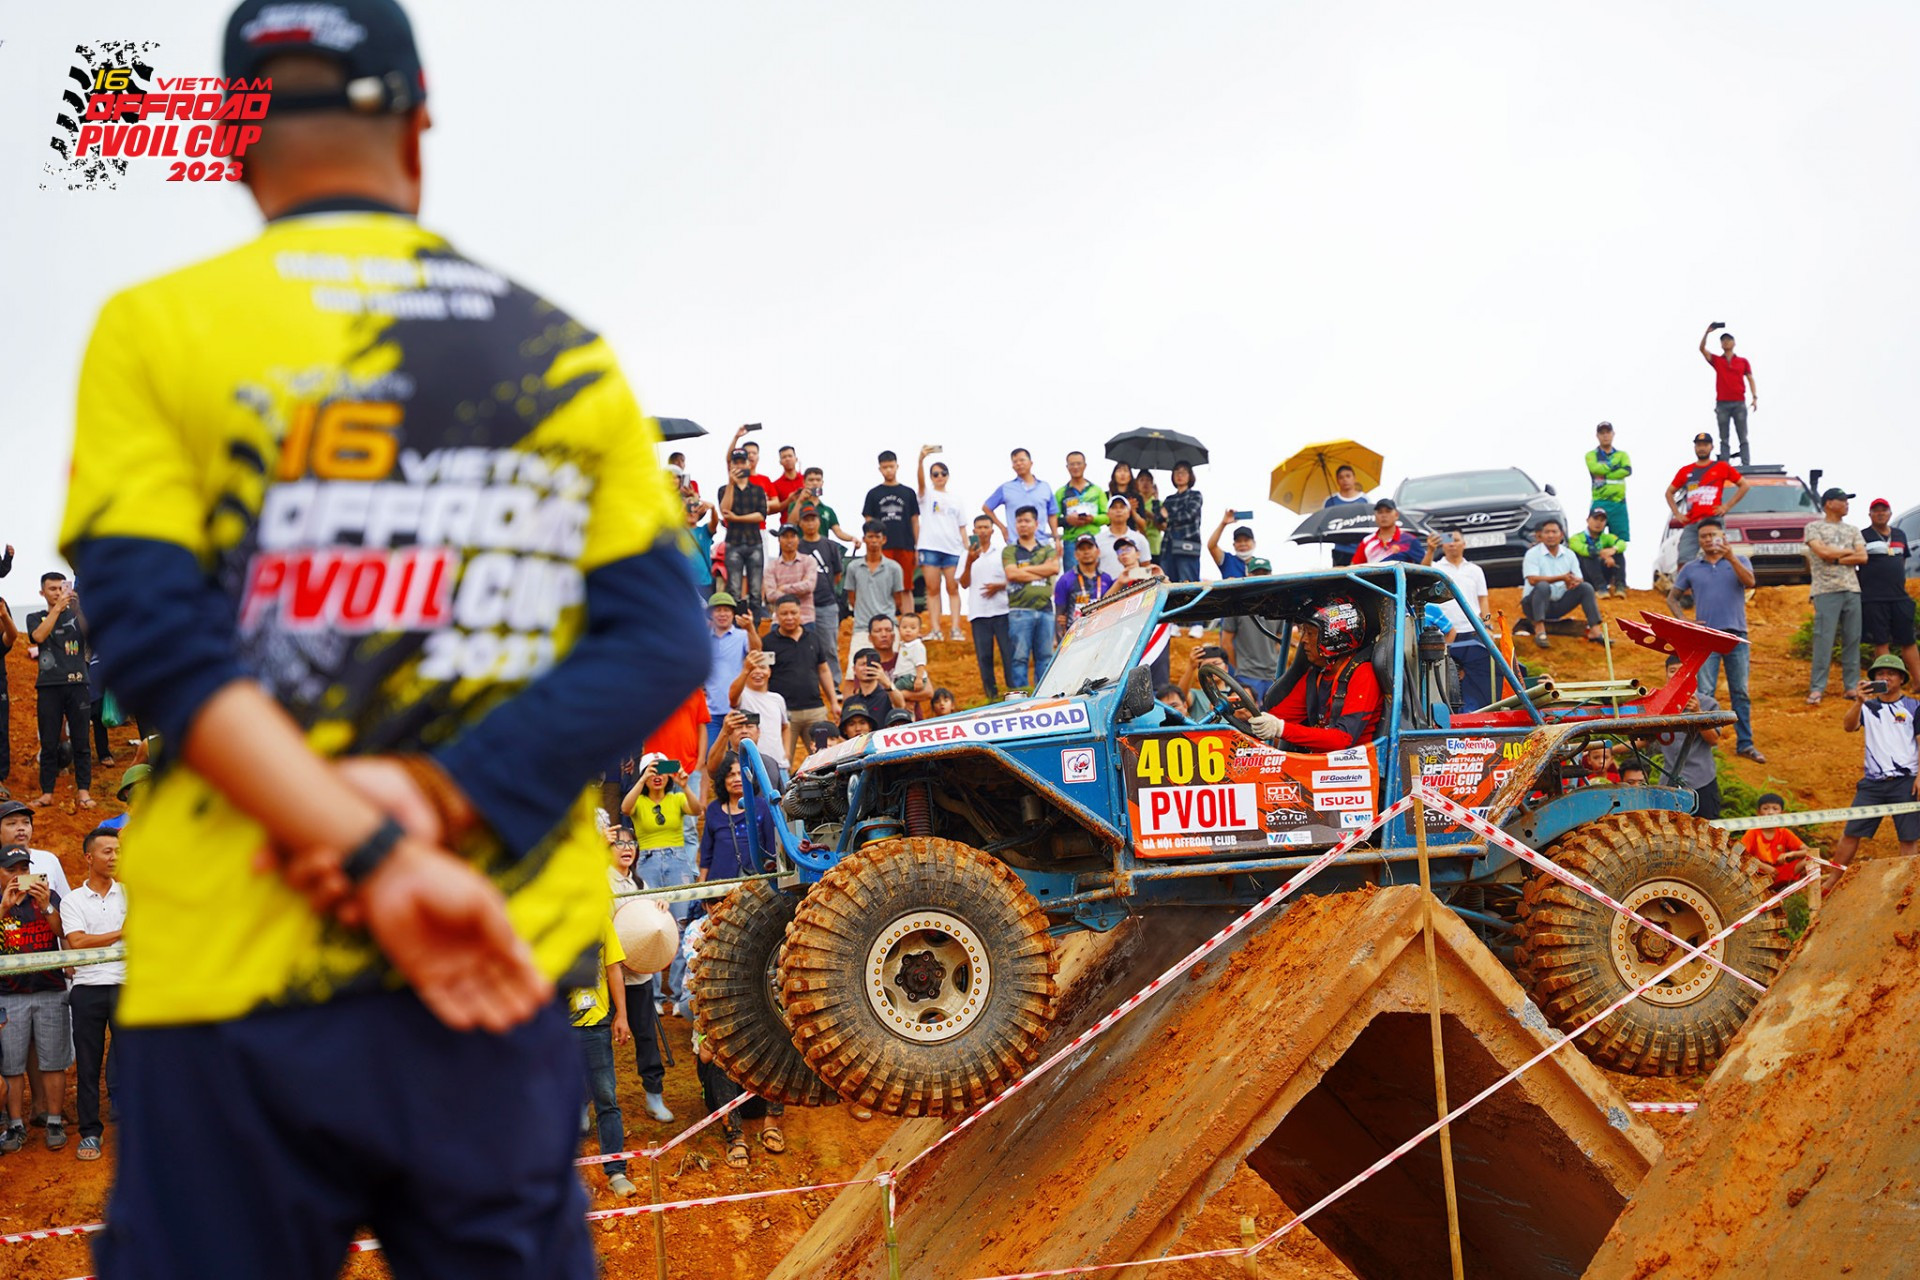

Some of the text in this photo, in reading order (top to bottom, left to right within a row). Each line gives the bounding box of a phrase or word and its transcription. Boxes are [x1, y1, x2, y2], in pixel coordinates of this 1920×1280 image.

[278, 401, 405, 480] 16
[240, 550, 458, 632] PVOIL
[883, 708, 1085, 748] KOREA OFFROAD
[1447, 739, 1495, 750] Ekokemika
[1137, 735, 1226, 785] 406
[1234, 755, 1287, 768] PVOIL CUP
[1425, 755, 1438, 764] 16
[1259, 766, 1282, 774] 2023
[1423, 763, 1484, 775] OFFROAD
[1320, 774, 1363, 782] BFGoodrich
[1422, 774, 1456, 787] PVOIL
[1457, 774, 1483, 786] CUP
[1452, 786, 1478, 795] 2023
[1267, 793, 1301, 802] MEDIA
[1320, 795, 1365, 806] ISUZU
[1151, 788, 1246, 831] PVOIL
[1142, 837, 1156, 849] HÀ
[1174, 836, 1213, 848] OFFROAD
[1214, 835, 1238, 846] CLUB
